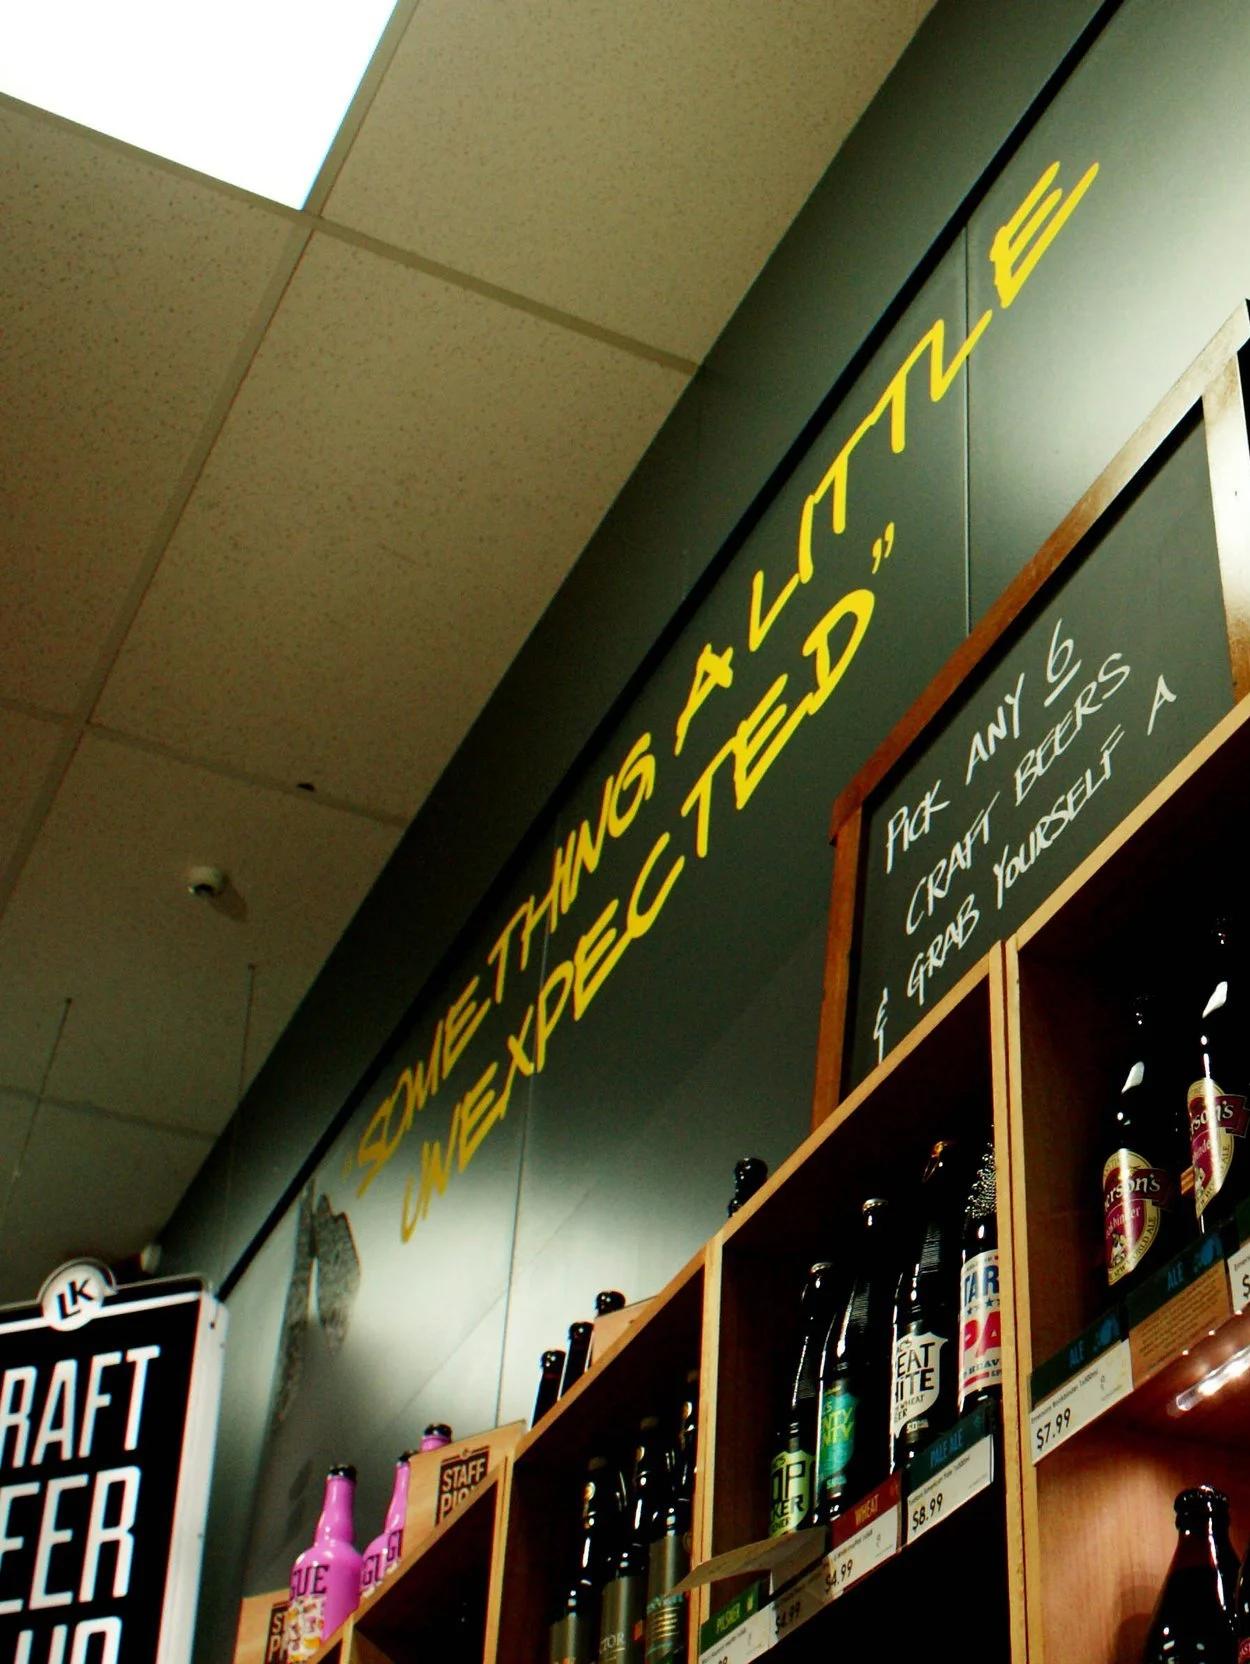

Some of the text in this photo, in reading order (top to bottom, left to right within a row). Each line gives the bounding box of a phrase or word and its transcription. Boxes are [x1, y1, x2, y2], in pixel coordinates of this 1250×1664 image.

[674, 643, 734, 756] A
[749, 161, 1099, 653] LITTLE
[886, 619, 1078, 874] PICK ANY 6
[906, 653, 1130, 936] CRAFT BEERS
[907, 894, 980, 1006] GRAB
[993, 724, 1125, 910] YOURSELF
[1148, 674, 1178, 736] A
[56, 1275, 94, 1320] LK
[1167, 1261, 1184, 1293] ALE
[1068, 1339, 1085, 1369] ALE
[1035, 1407, 1072, 1451] $7.99
[442, 1457, 487, 1493] STAFF
[854, 1493, 880, 1527] WHEAT
[911, 1493, 944, 1534] $8.99
[825, 1559, 854, 1596] $4.99
